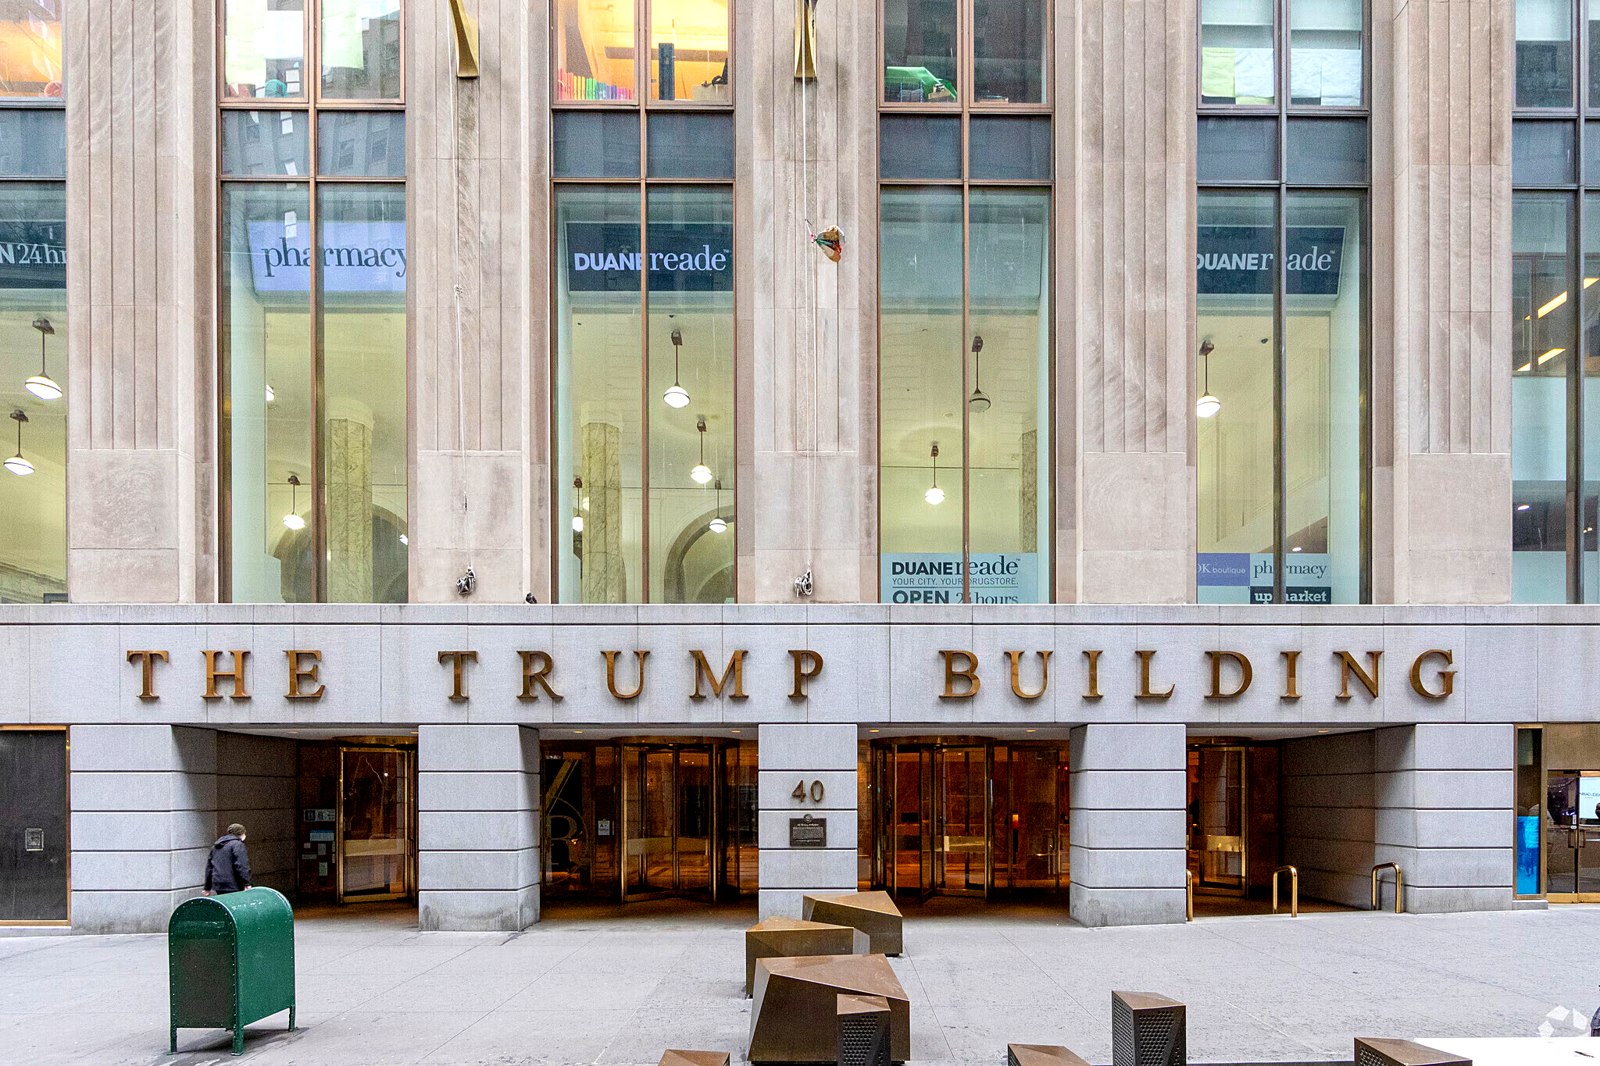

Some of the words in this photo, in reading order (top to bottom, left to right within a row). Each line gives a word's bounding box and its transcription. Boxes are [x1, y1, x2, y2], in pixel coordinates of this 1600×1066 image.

[574, 252, 642, 271] DUANE
[1259, 246, 1332, 271] rade
[892, 561, 953, 575] DUANE
[954, 555, 1018, 575] reade
[1253, 560, 1327, 579] phmacy
[892, 577, 915, 586] YOUR
[917, 577, 938, 586] CITY.
[967, 577, 1019, 586] RUGSTORE.
[892, 590, 950, 604] OPEN
[974, 591, 1019, 604] hours
[126, 649, 326, 700] THE
[438, 649, 824, 700] TRUMP
[938, 648, 1459, 700] BUILDING
[791, 779, 825, 803] 40
